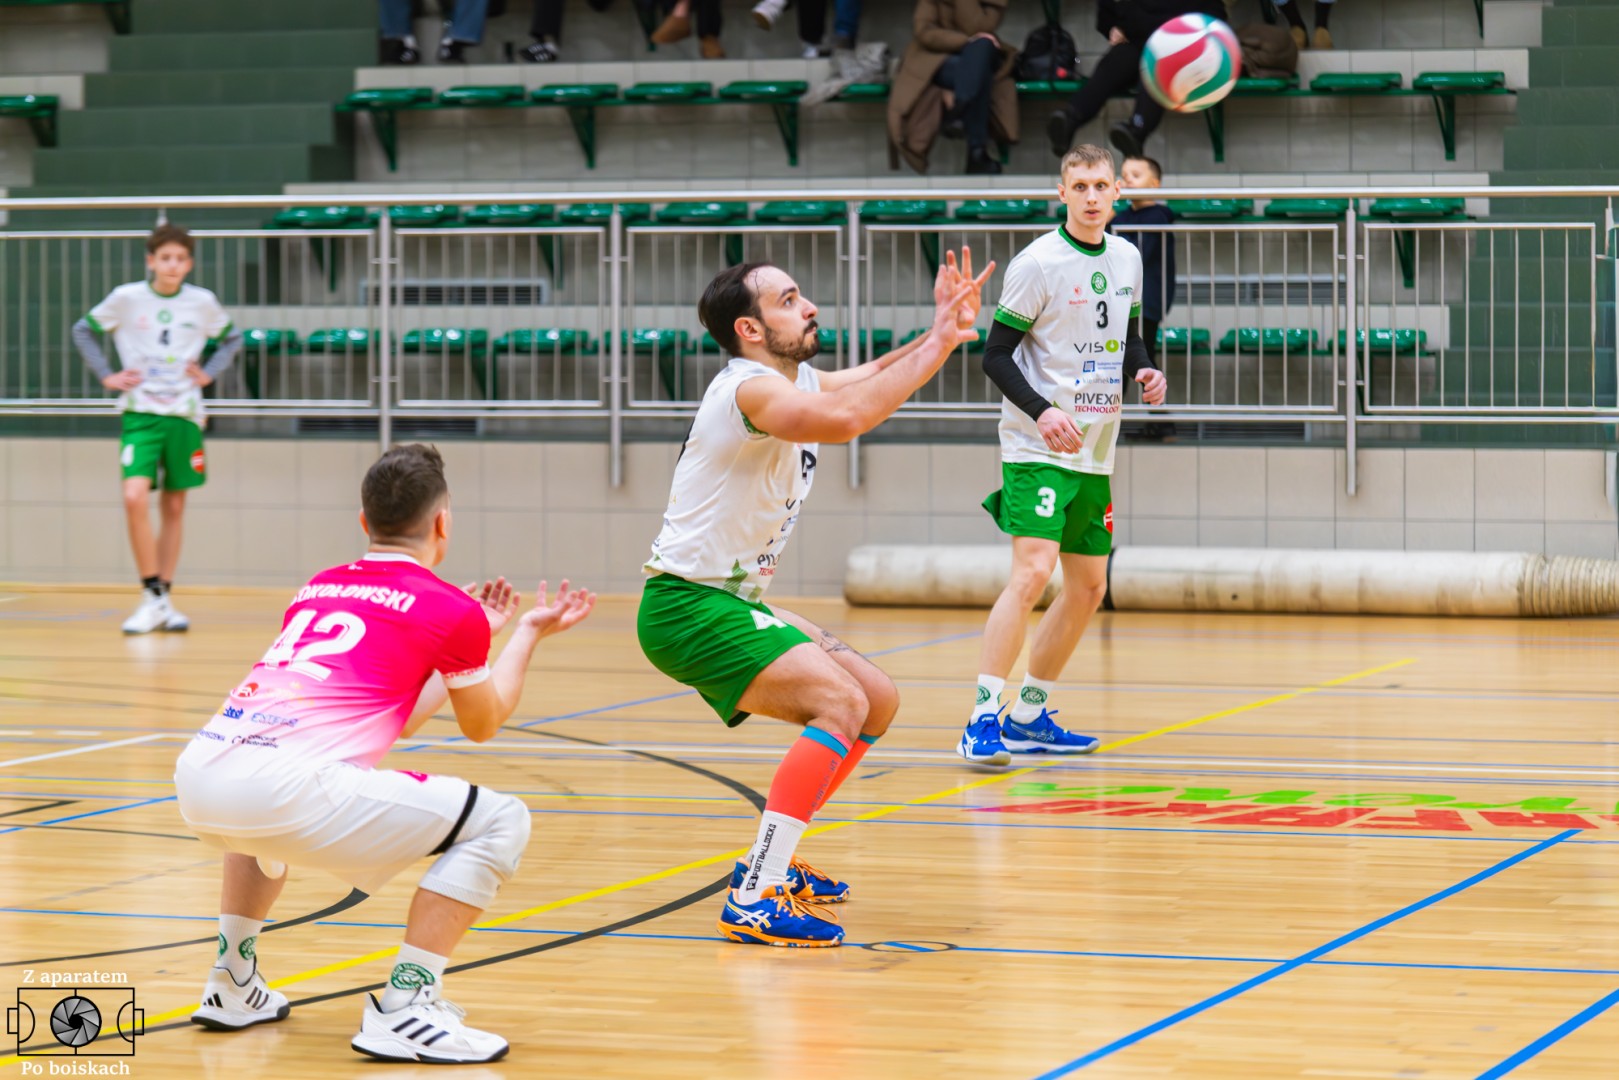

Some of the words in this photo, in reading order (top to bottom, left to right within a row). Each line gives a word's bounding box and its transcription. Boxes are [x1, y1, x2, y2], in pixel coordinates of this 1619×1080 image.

[1096, 301, 1108, 329] 3
[1035, 486, 1056, 518] 3
[262, 609, 366, 682] 42
